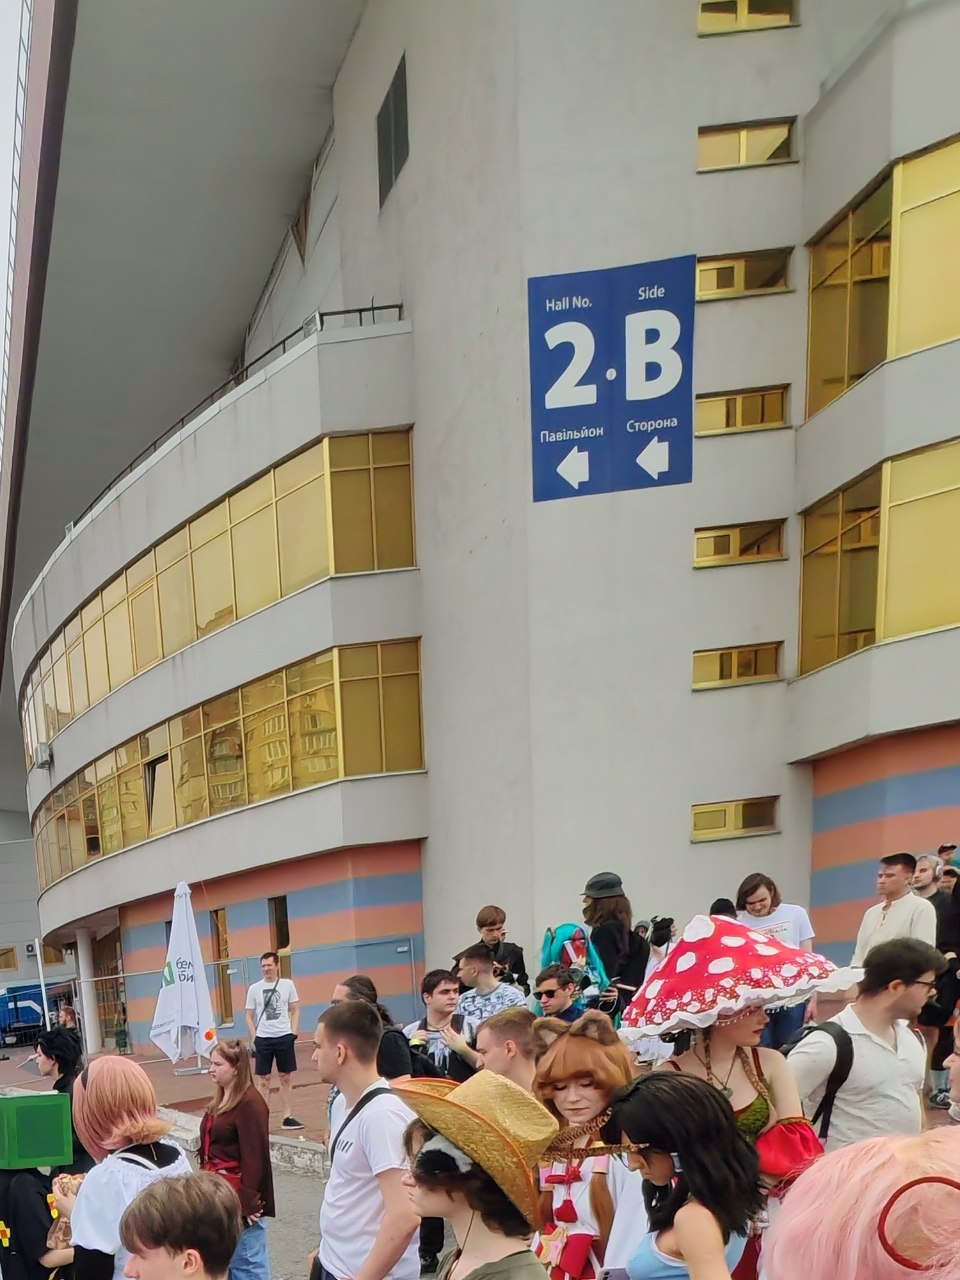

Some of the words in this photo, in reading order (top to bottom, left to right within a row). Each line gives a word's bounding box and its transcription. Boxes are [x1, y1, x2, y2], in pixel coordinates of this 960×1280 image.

[638, 285, 666, 300] Side
[546, 297, 569, 312] Hall
[572, 295, 593, 309] No.
[626, 417, 678, 433] Сторона
[540, 426, 604, 443] Павільйон
